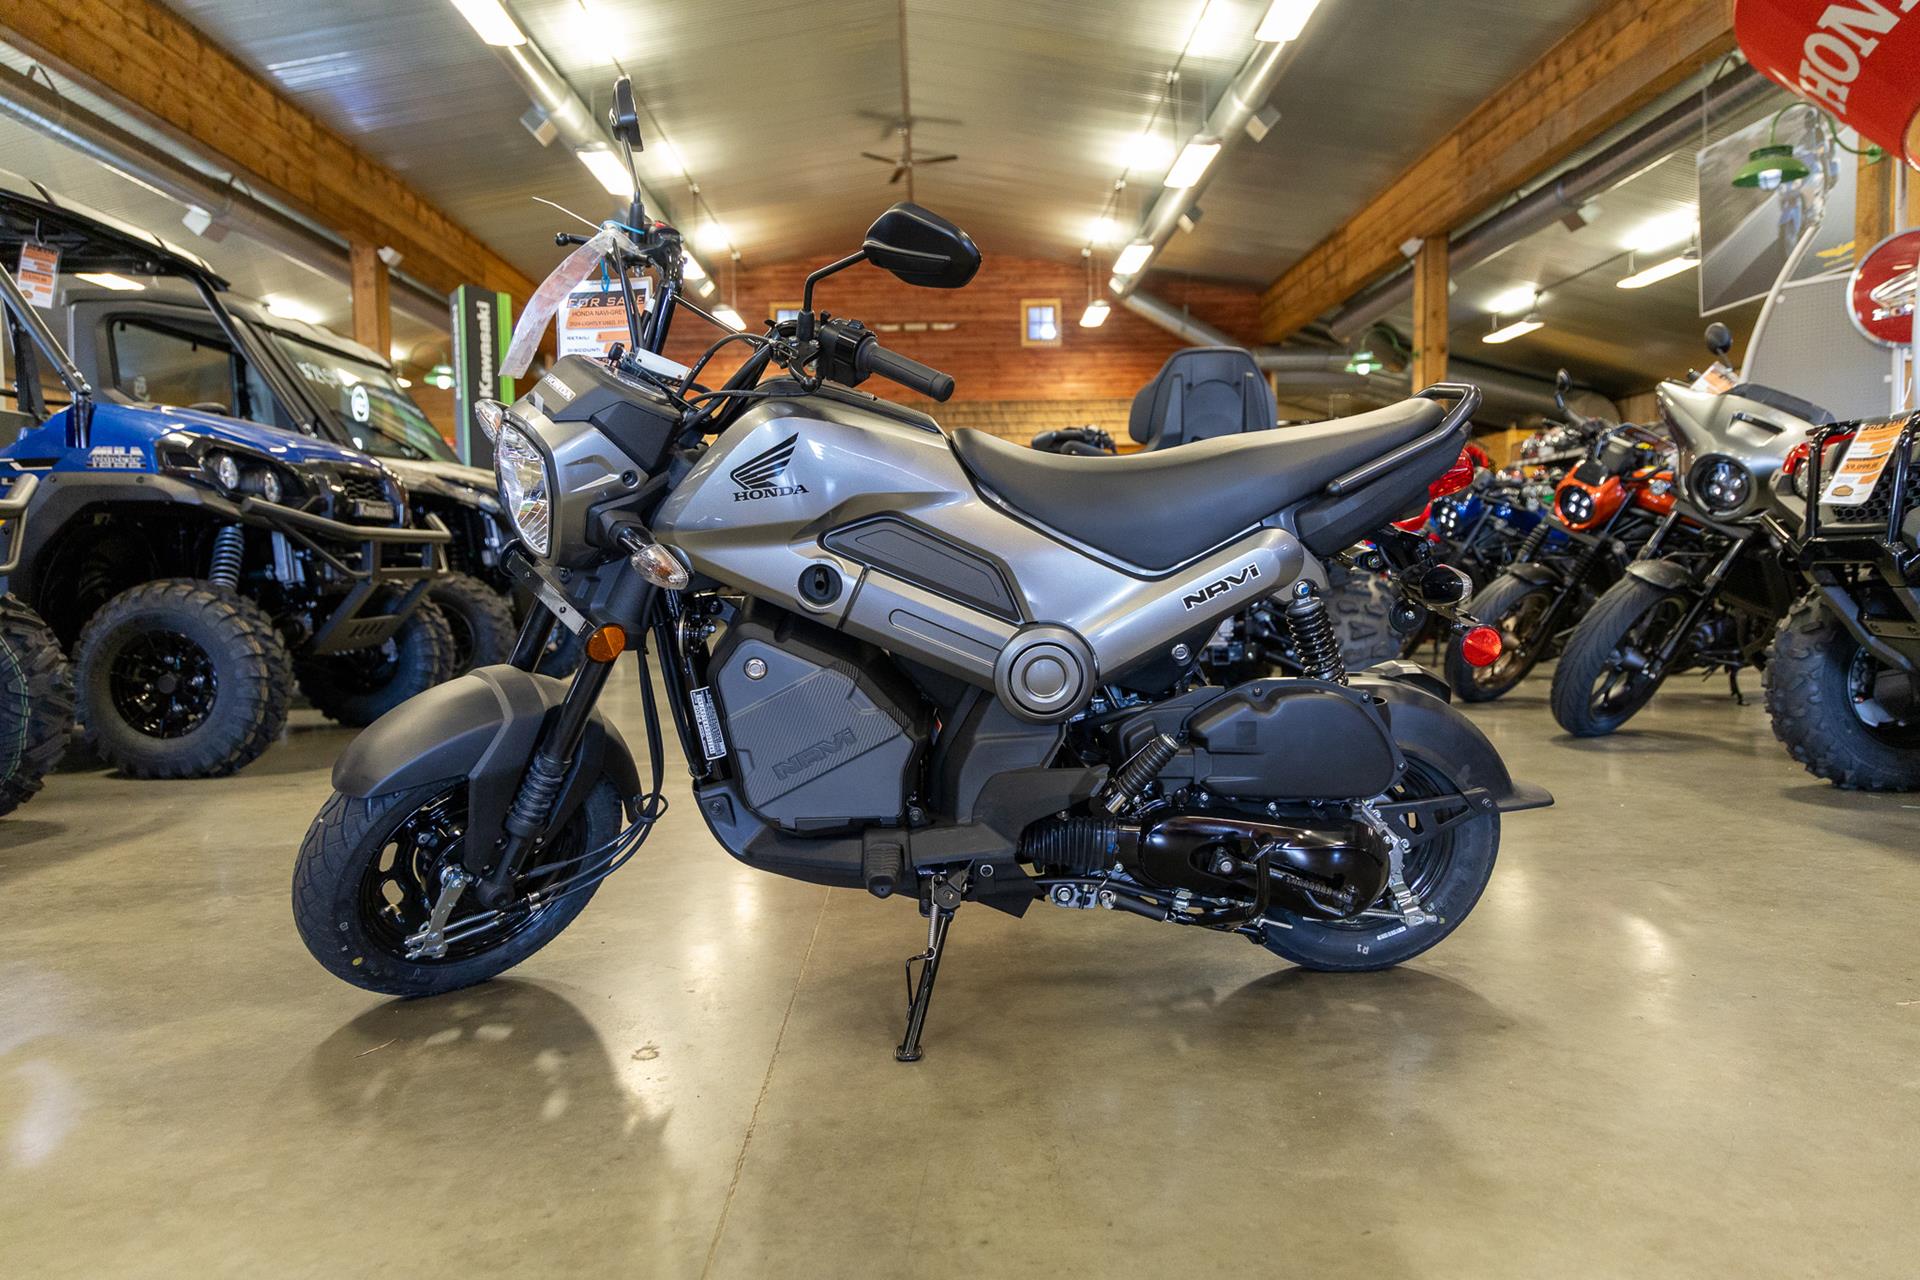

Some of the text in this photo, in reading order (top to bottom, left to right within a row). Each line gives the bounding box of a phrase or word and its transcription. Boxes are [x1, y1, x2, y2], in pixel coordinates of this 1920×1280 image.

[1799, 0, 1920, 115] HON
[568, 294, 645, 308] FOR SAE
[572, 310, 594, 318] HONDA
[476, 300, 494, 398] Kawasaki
[546, 375, 574, 400] HONDA
[733, 484, 809, 502] HONDA
